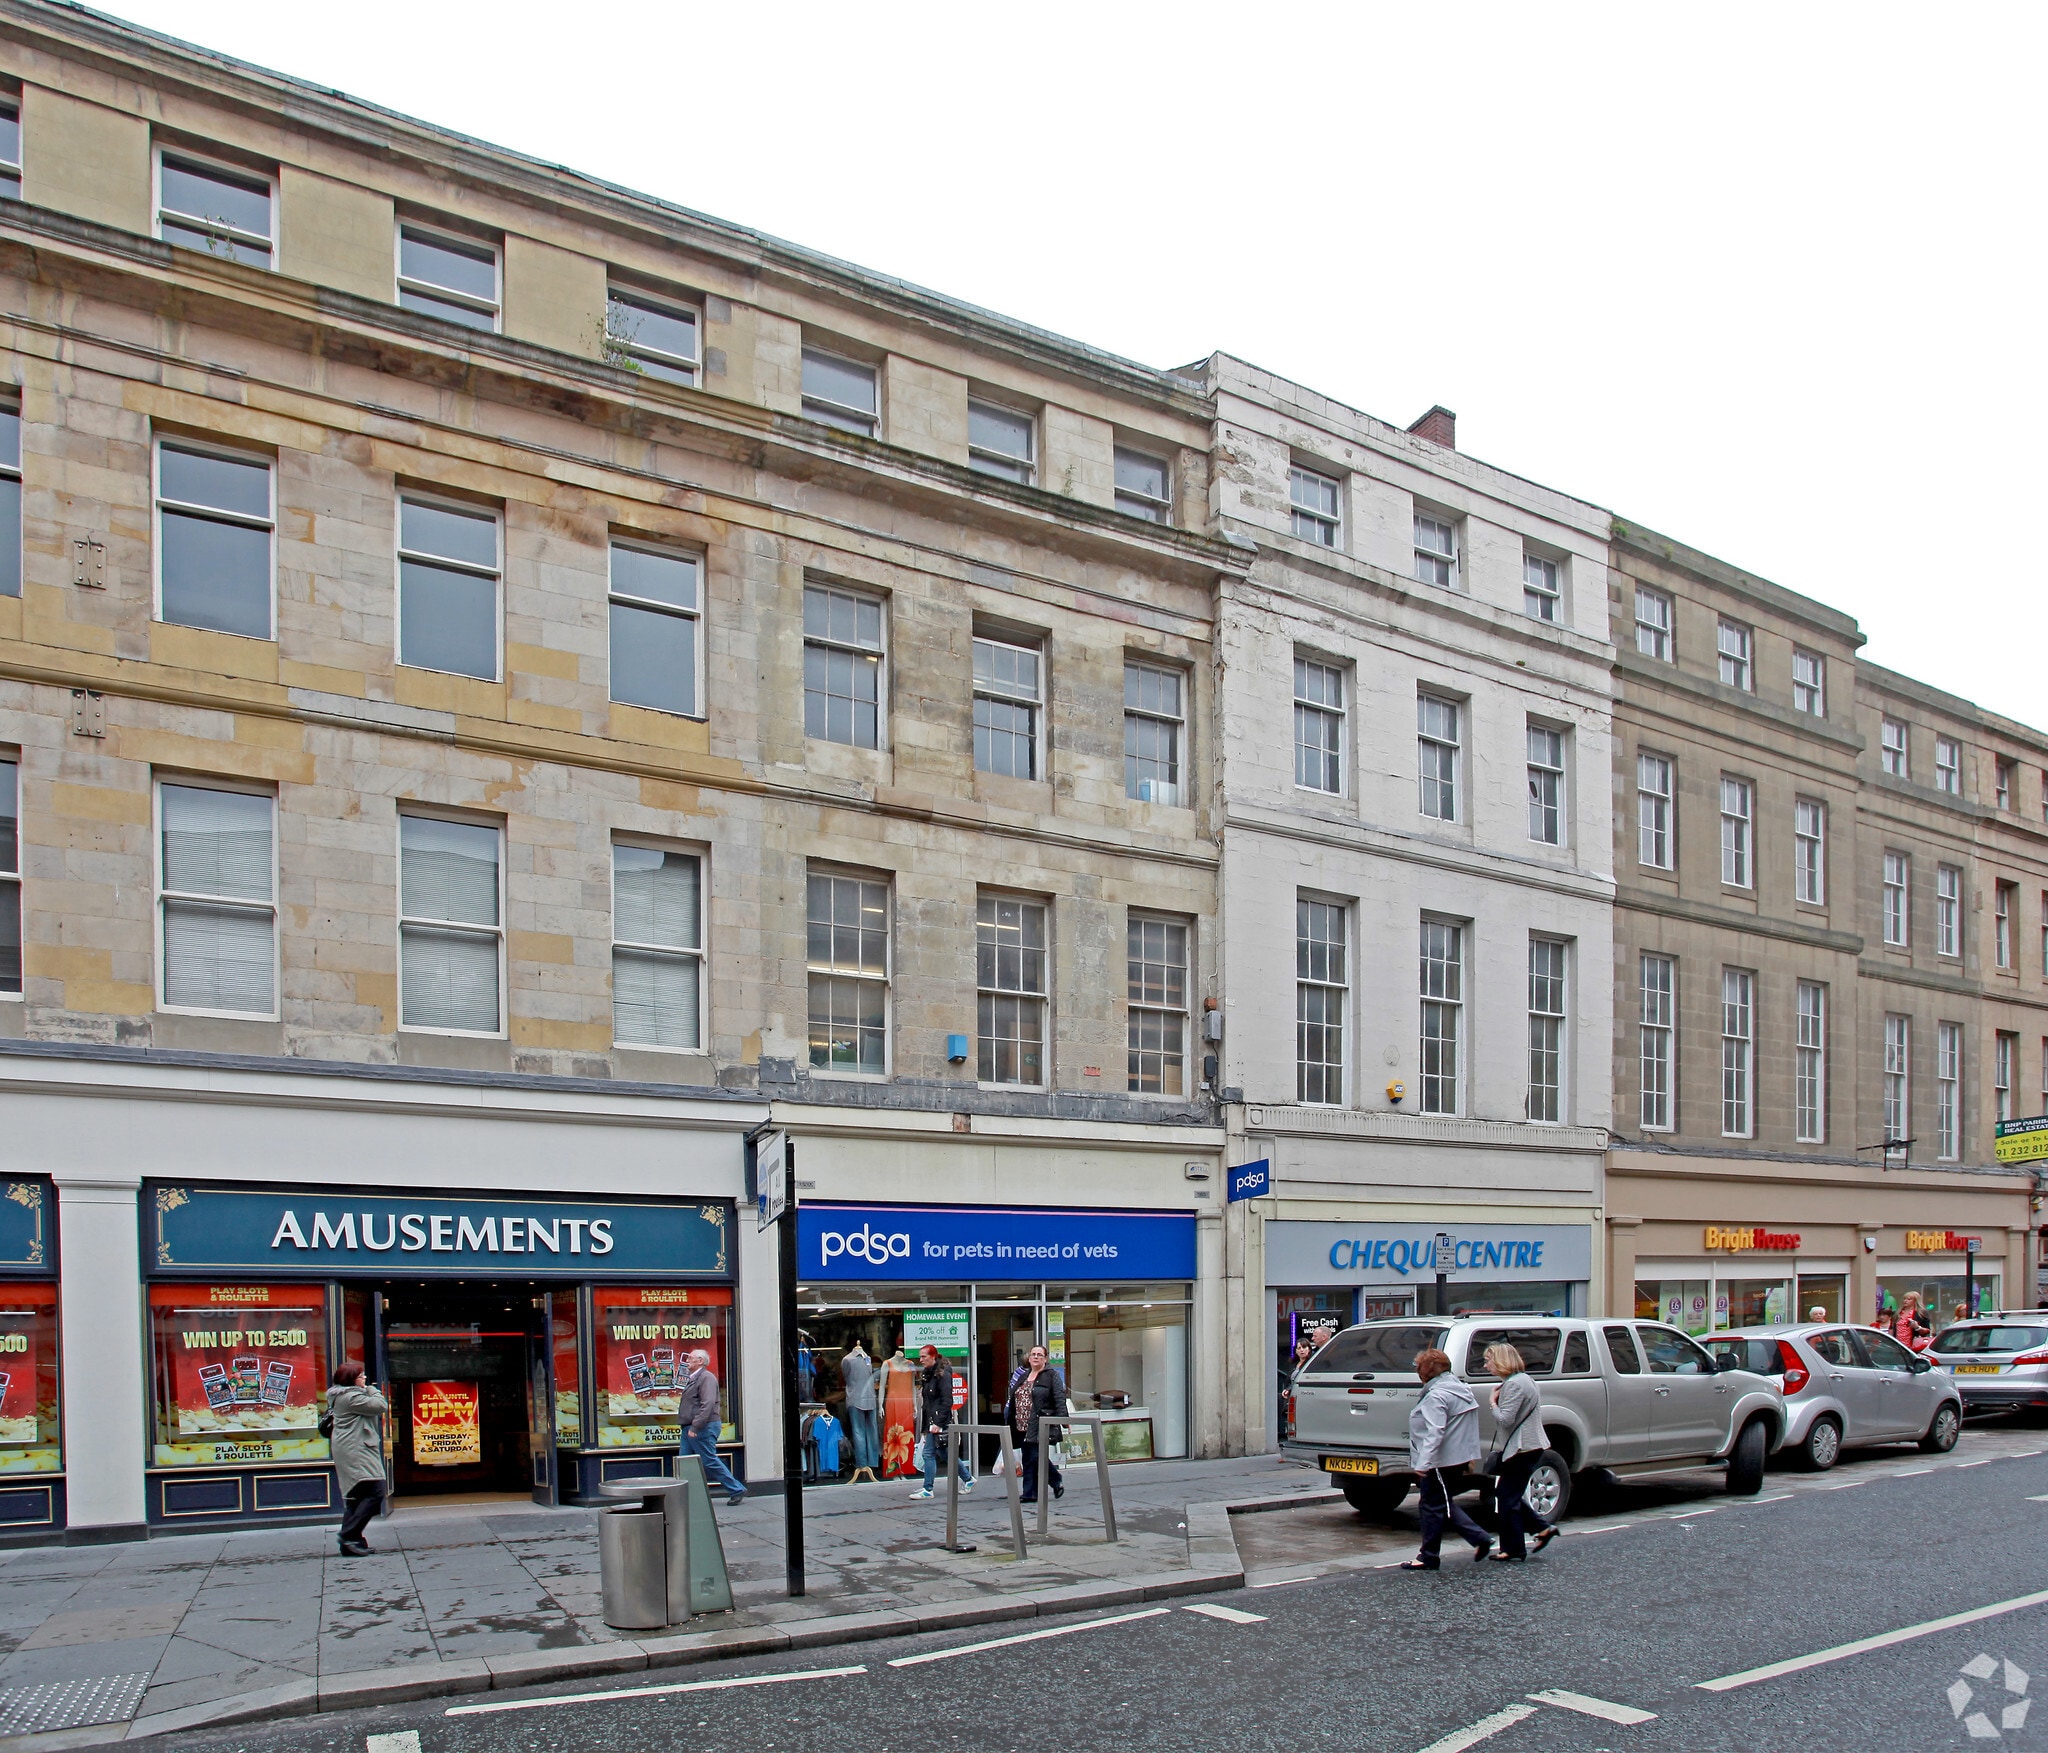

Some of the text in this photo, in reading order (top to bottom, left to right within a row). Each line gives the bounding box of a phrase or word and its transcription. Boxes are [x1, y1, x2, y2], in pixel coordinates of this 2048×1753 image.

[2025, 1123, 2048, 1131] ESTAT
[1995, 1149, 2007, 1157] 91
[2010, 1146, 2029, 1155] 232
[2032, 1144, 2048, 1153] 812
[1236, 1171, 1264, 1192] pdsa
[271, 1210, 614, 1254] AMUSEMENTS
[1705, 1226, 1801, 1253] BrightHouse
[821, 1223, 1118, 1266] pdsa for pets in need of vets
[1906, 1230, 1982, 1253] BrightHou
[1456, 1240, 1544, 1269] CENTRE
[1671, 1301, 1680, 1310] £6
[1695, 1300, 1703, 1309] £9
[1301, 1317, 1339, 1327] Free Cash
[613, 1324, 711, 1340] WIN UP TO £500
[918, 1326, 945, 1335] 20% off
[0, 1335, 27, 1353] 500
[183, 1329, 307, 1349] WIN UP TO £500
[418, 1402, 473, 1418] 11PM
[223, 1451, 273, 1460] ROULETTE
[242, 1444, 273, 1452] SLOTS
[1329, 1459, 1374, 1471] NK05 VVS
